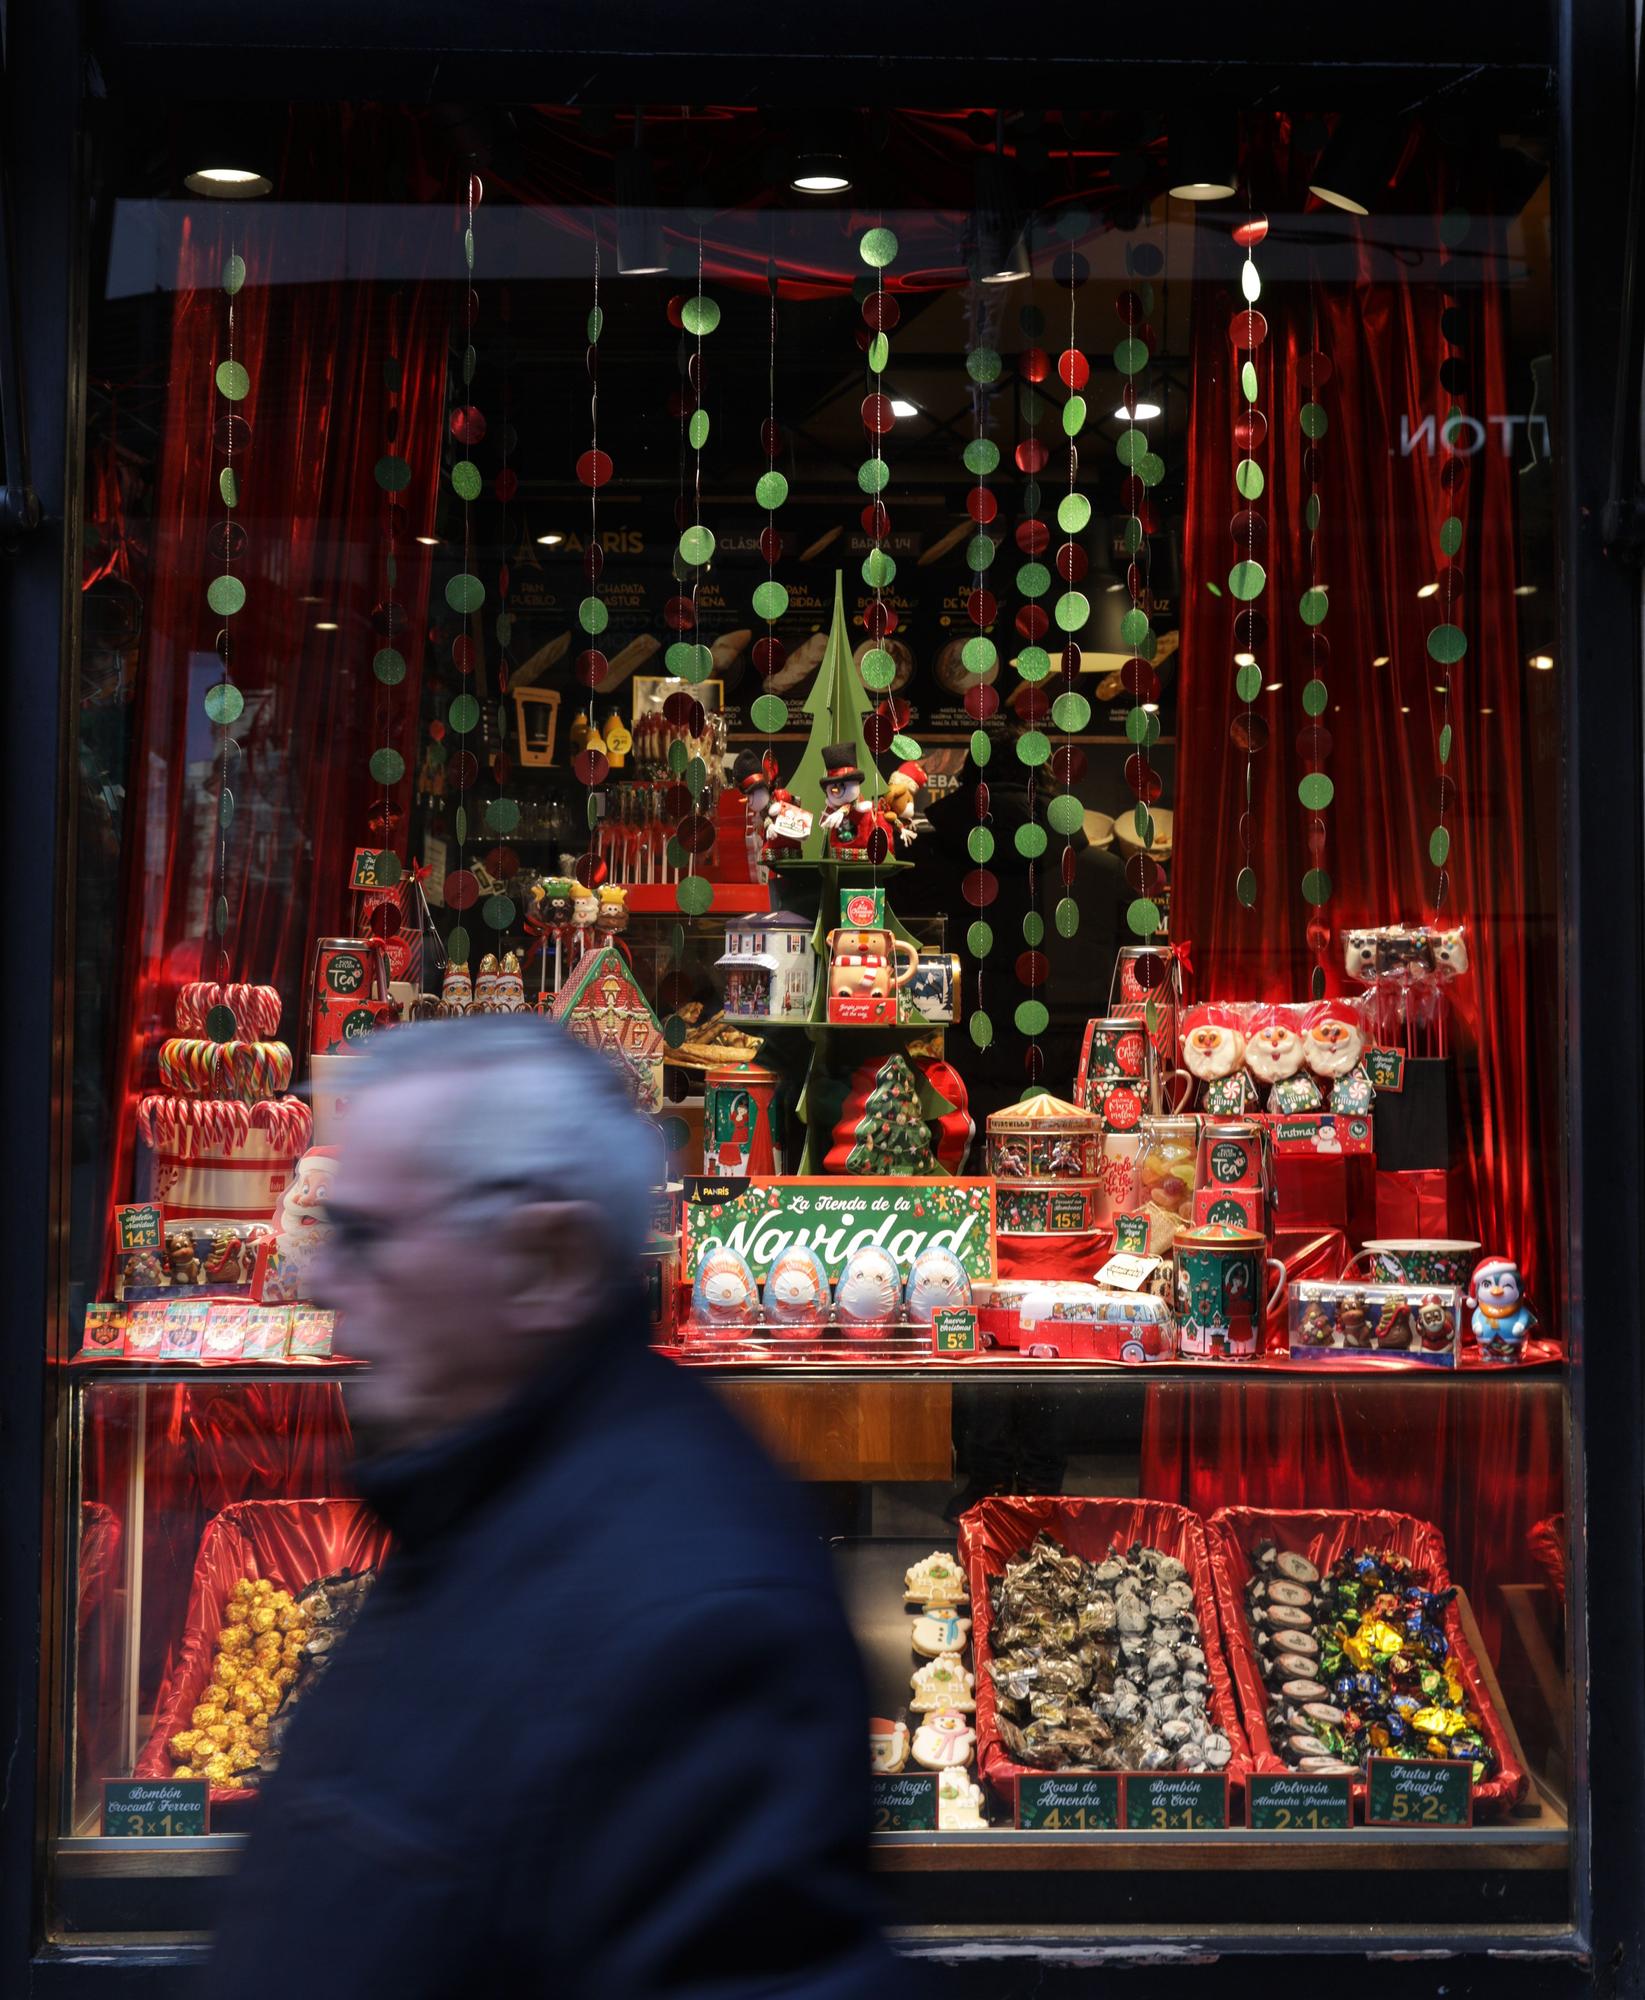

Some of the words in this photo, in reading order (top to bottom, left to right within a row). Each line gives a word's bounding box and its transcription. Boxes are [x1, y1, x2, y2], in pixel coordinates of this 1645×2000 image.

[511, 595, 557, 607] PUEBLO
[328, 969, 358, 988] Tea
[1375, 1070, 1385, 1085] 3
[1277, 1122, 1316, 1139] hristmas
[1211, 1158, 1241, 1177] Tea
[703, 1186, 730, 1196] PANRÍS
[787, 1195, 810, 1215] La
[815, 1196, 868, 1211] Tienda
[871, 1196, 891, 1211] de
[894, 1196, 912, 1211] la
[1055, 1213, 1071, 1228] 15
[126, 1230, 145, 1247] 14
[696, 1209, 978, 1265] Navidad
[1122, 1237, 1133, 1251] 2
[948, 1333, 958, 1349] 5
[1391, 1765, 1431, 1780] Frutas
[1435, 1769, 1450, 1782] de
[128, 1786, 182, 1800] Bombón
[891, 1780, 932, 1796] Magic
[1040, 1779, 1078, 1793] Rocas
[1082, 1779, 1098, 1793] de
[1149, 1779, 1201, 1793] Bombón
[1270, 1780, 1329, 1795] Polvorón
[1395, 1780, 1444, 1797] Aragón
[108, 1800, 156, 1813] Crocanti
[158, 1799, 201, 1812] Ferrero
[1036, 1793, 1101, 1807] Almendra
[1152, 1794, 1167, 1806] de
[1170, 1794, 1199, 1807] Coco
[1252, 1796, 1300, 1807] Almendra
[1302, 1795, 1347, 1807] Premium
